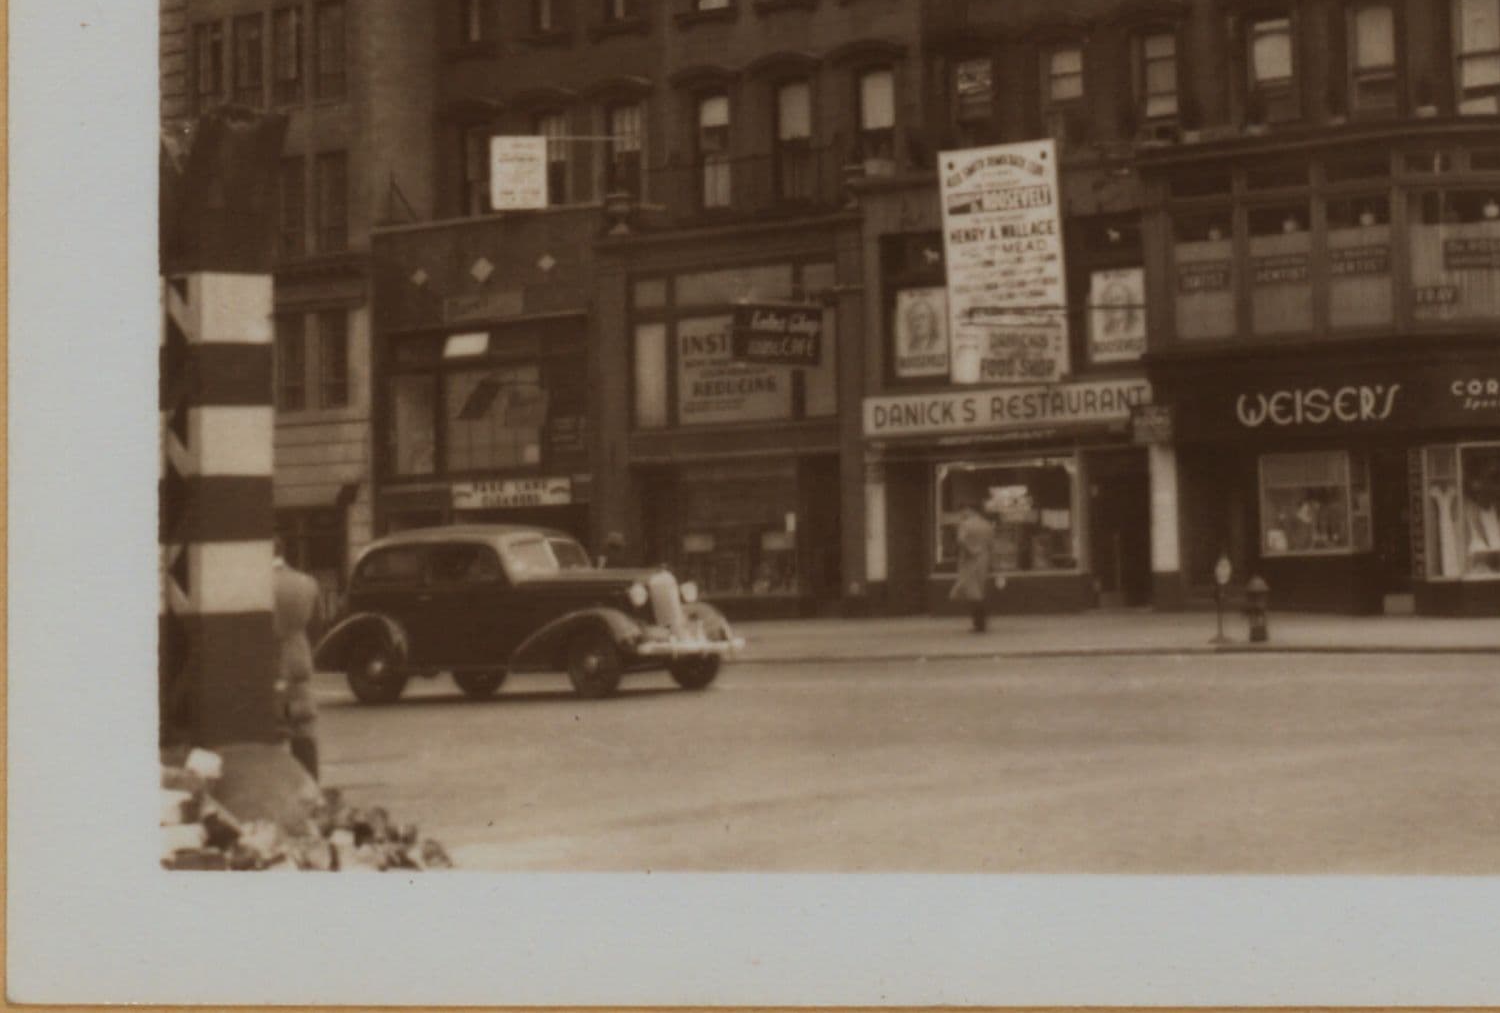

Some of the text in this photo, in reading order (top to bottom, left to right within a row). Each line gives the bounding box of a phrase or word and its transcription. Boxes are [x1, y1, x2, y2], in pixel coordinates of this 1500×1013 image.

[950, 228, 985, 244] HENRY
[1001, 219, 1056, 238] WALLACE
[1001, 239, 1047, 254] MEAD
[693, 376, 777, 396] REDUCING
[989, 386, 1147, 418] RESTAURANT
[1236, 383, 1401, 427] WEISER'S
